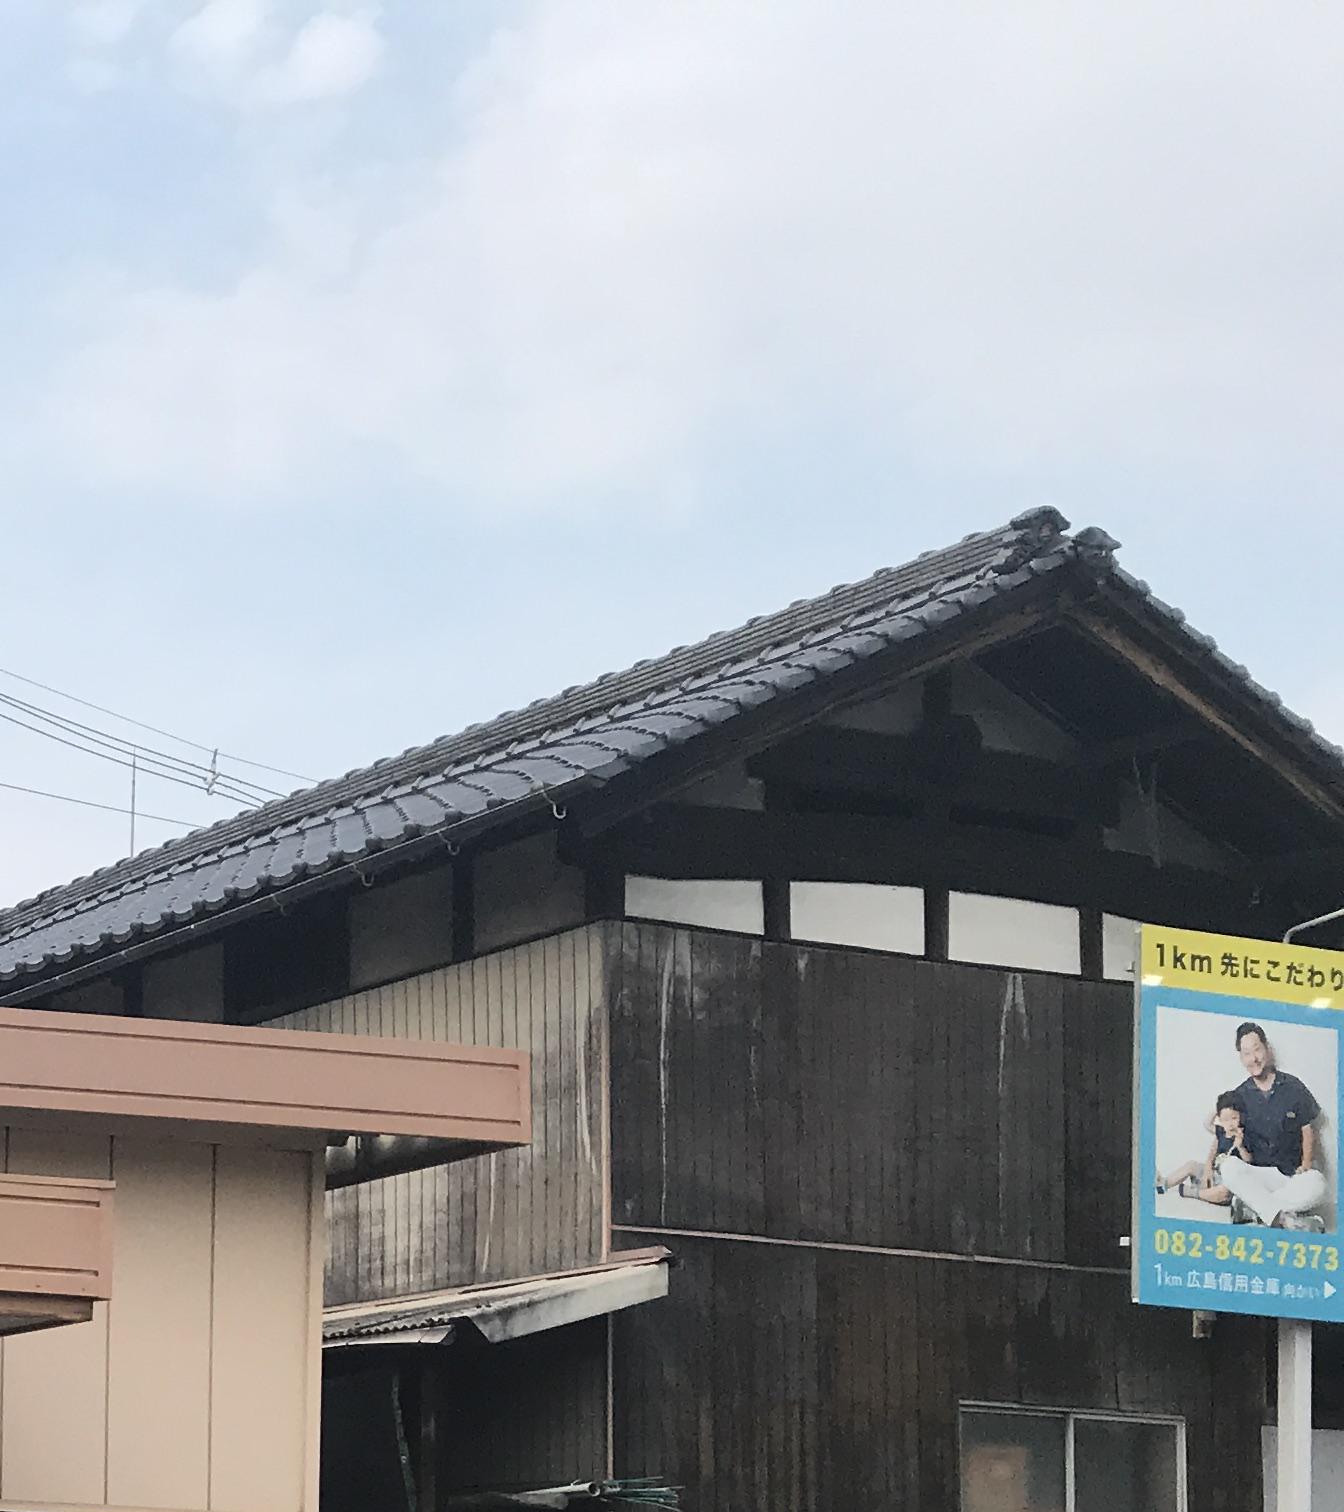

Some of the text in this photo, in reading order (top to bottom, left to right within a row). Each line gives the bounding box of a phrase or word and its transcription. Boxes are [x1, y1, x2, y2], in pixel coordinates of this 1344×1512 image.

[1156, 943, 1344, 991] 1km 先にこだわり
[1154, 1228, 1339, 1272] 082-842-7373
[1154, 1263, 1183, 1287] 1km
